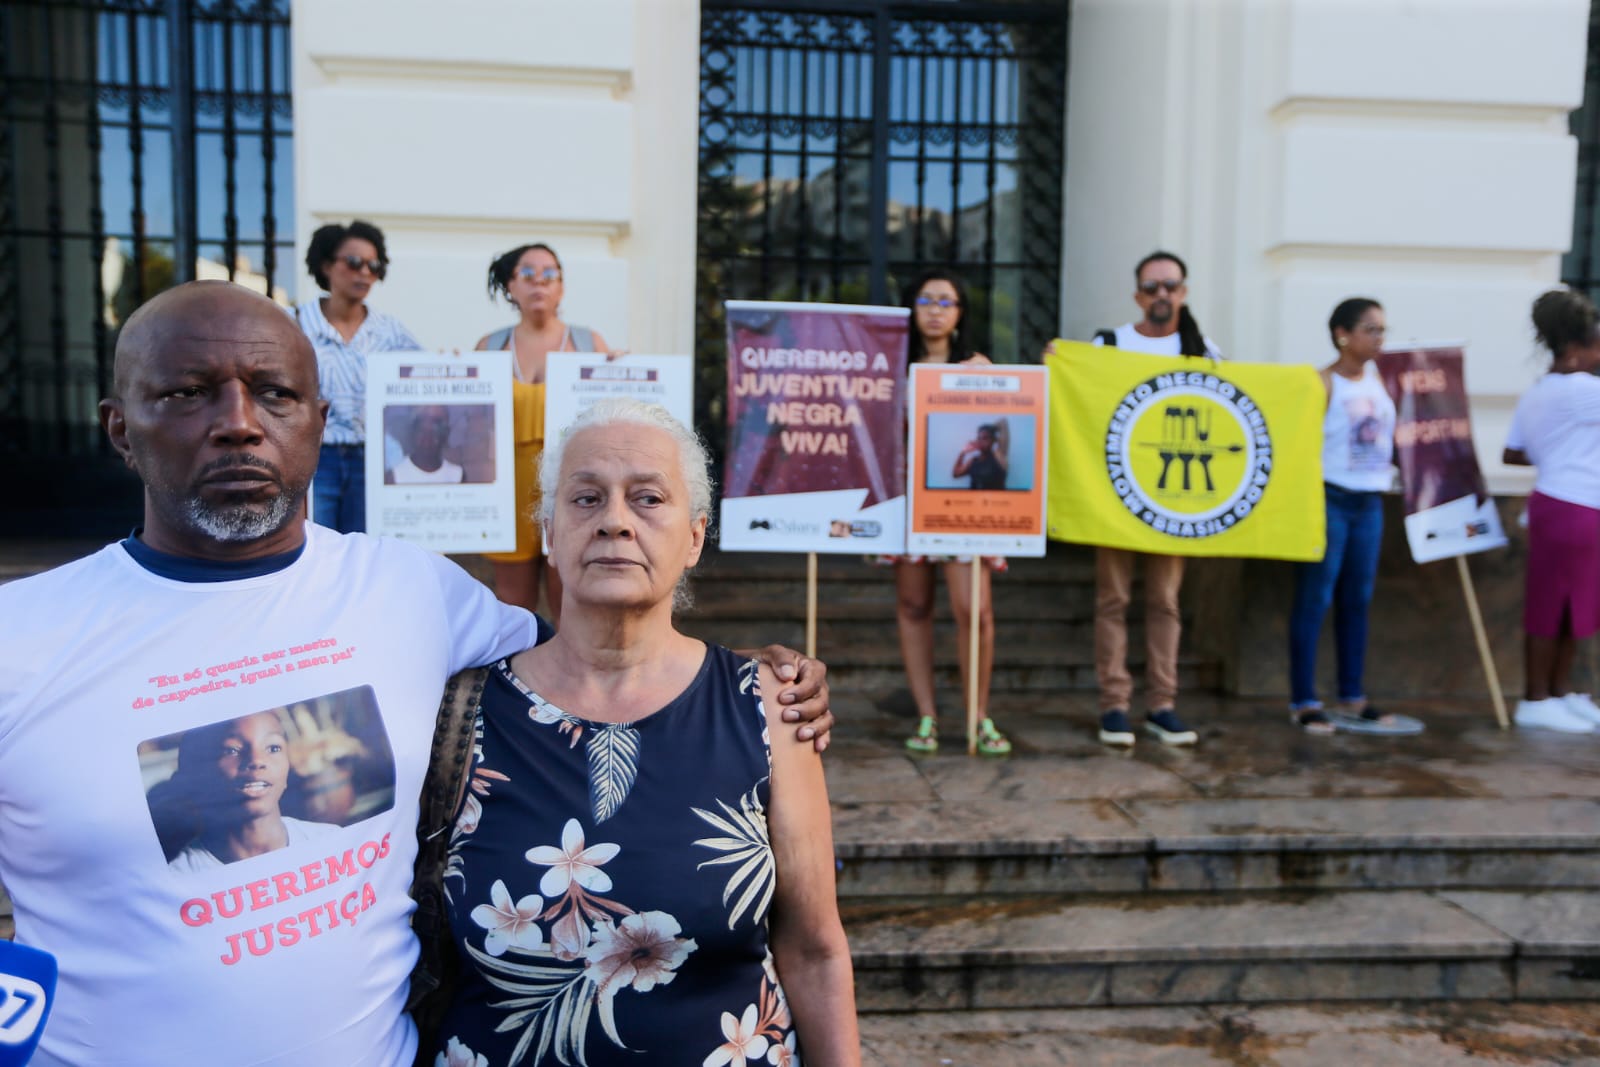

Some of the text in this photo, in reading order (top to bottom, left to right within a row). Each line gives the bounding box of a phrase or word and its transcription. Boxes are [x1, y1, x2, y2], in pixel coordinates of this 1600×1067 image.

[740, 347, 890, 371] QUEREMOS A
[423, 382, 448, 394] SILVA
[734, 374, 895, 400] JUVENTUDE
[766, 402, 863, 426] NEGRA
[780, 431, 849, 455] VIVA!
[1106, 372, 1272, 518] MOVIMENTO NEGRO UNIFICADO
[1152, 516, 1227, 538] BRASIL
[183, 668, 203, 682] só
[206, 654, 260, 678] queria
[262, 650, 286, 662] ser
[289, 637, 337, 655] mestre
[132, 696, 155, 710] de
[158, 679, 237, 703] capoeira,
[240, 664, 283, 684] igual
[285, 663, 295, 673] a
[297, 656, 330, 670] meu
[179, 832, 392, 927] QUEREMOS
[220, 881, 377, 966] JUSTIÇA
